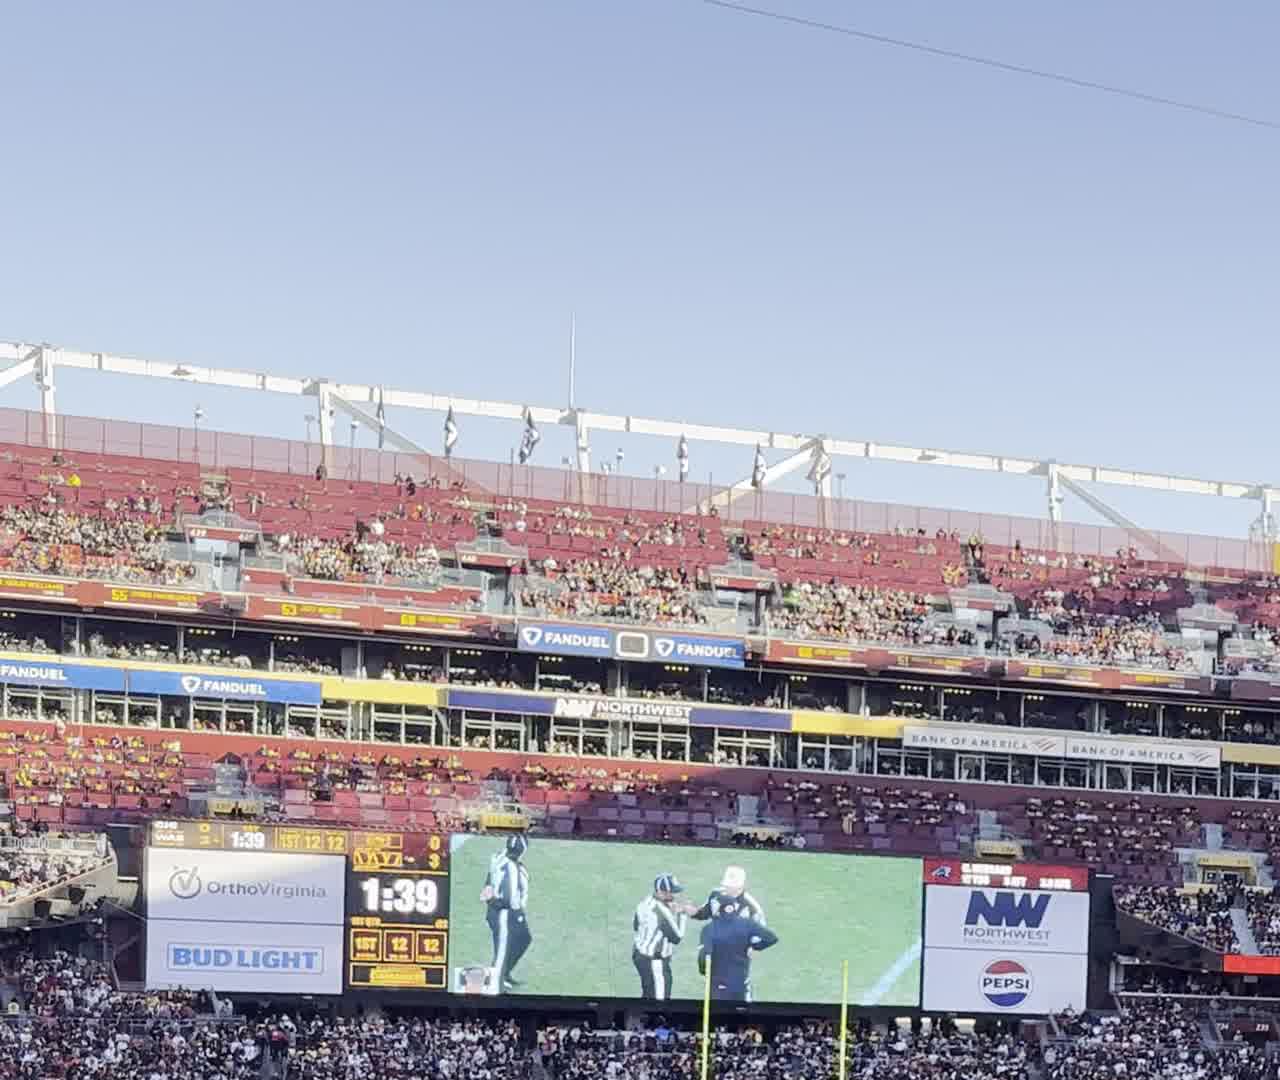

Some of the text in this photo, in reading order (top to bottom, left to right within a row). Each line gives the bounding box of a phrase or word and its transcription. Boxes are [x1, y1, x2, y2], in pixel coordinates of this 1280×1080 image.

[544, 632, 609, 648] FANDUEL
[676, 644, 741, 659] FANDUEL
[203, 681, 266, 696] FANDUEL
[596, 702, 692, 717] NORTHWEST
[911, 735, 1029, 750] BANK OF AMERICA
[1072, 745, 1185, 761] BANK OF AMERICA
[230, 831, 265, 849] 1:39
[207, 881, 327, 900] OrthoVirginia
[360, 877, 438, 914] 1:39
[965, 891, 1051, 928] NW
[964, 927, 1049, 940] NORTHWEST
[391, 937, 408, 951] 12
[424, 938, 439, 952] 12
[173, 948, 318, 970] BUD LIGHT
[983, 977, 1030, 990] PEPSI
